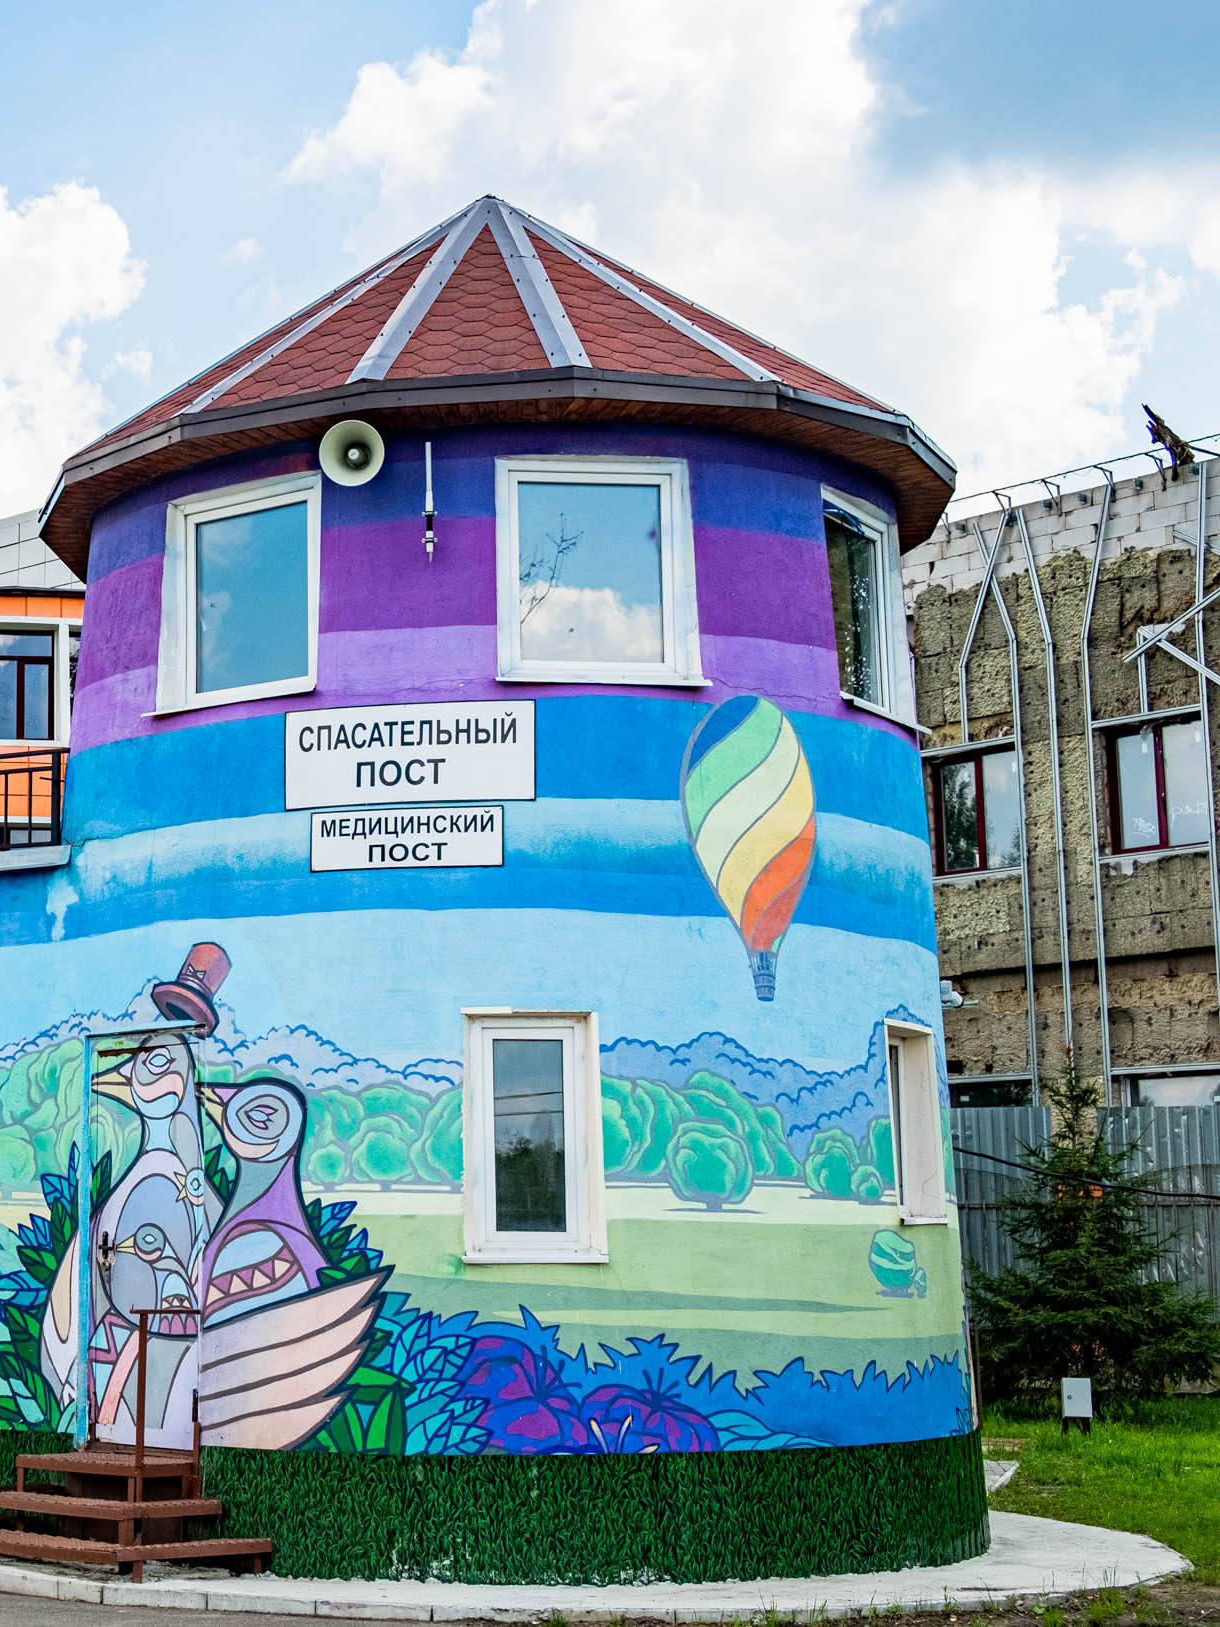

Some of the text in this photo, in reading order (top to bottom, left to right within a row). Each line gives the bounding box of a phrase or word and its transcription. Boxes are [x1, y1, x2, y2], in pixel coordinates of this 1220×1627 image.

[298, 711, 517, 753] СПАСАТЕЛЬНЫЙ
[355, 758, 446, 788] ПОСТ
[320, 809, 495, 840] МЕДИЦИНСКИЙ
[368, 842, 448, 863] ПОСТ
